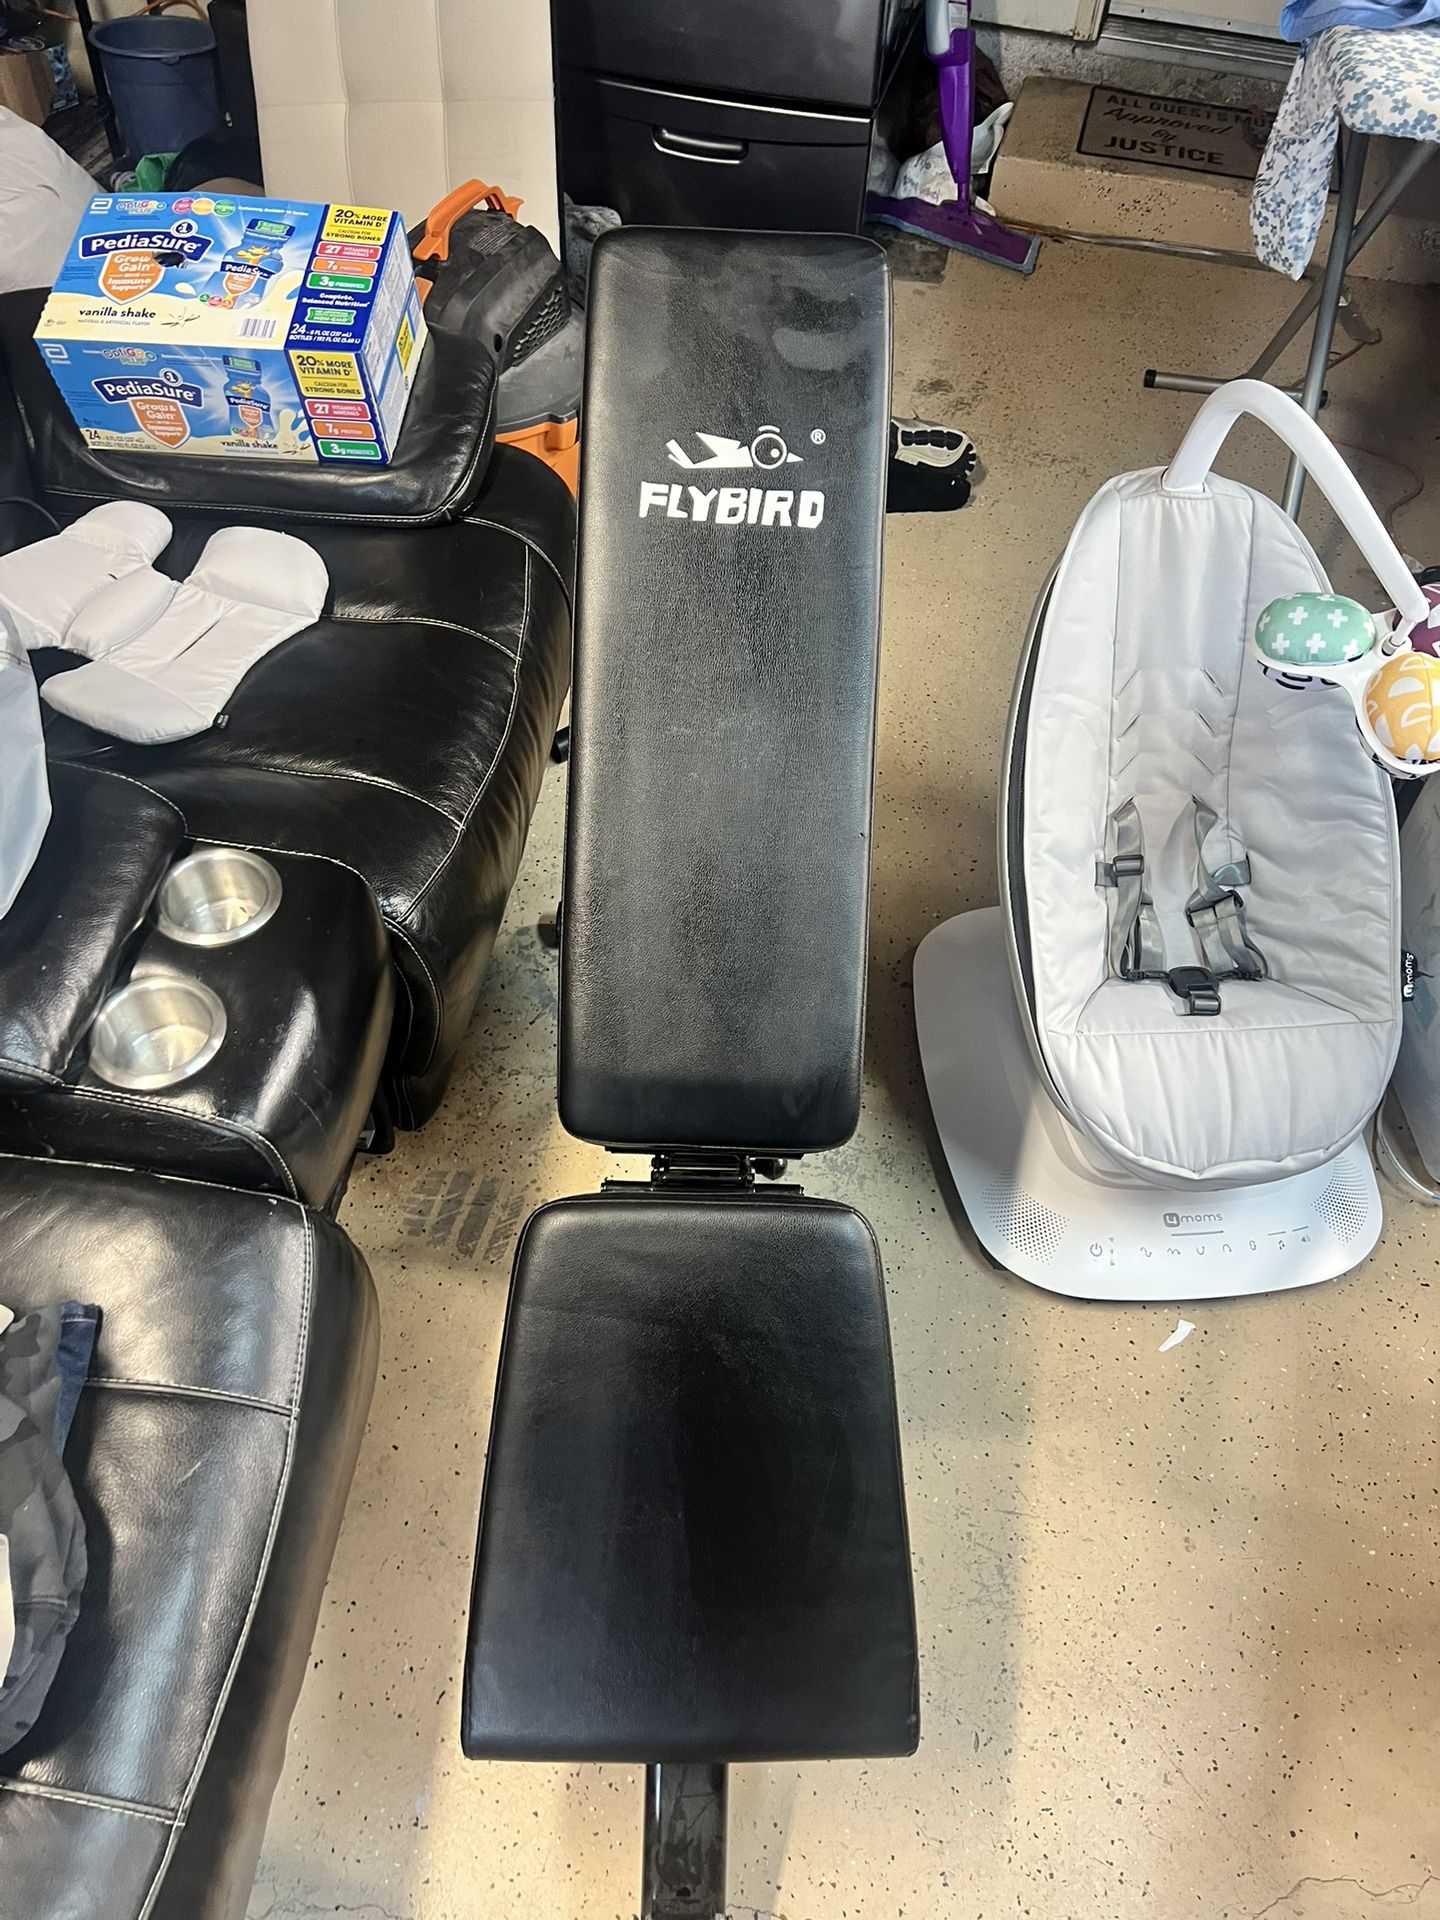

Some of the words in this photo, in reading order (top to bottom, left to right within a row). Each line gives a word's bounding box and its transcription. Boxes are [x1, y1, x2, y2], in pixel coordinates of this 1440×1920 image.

[1106, 94, 1143, 109] ALL
[1150, 101, 1228, 122] GUESTS
[1103, 107, 1233, 135] Approved
[1103, 136, 1224, 165] JUSTICE
[334, 209, 360, 219] 20%
[362, 214, 388, 222] MORE
[333, 218, 373, 227] VITAMIN
[91, 234, 199, 253] PediaSure
[324, 245, 342, 254] 27
[119, 262, 150, 272] Gain
[79, 307, 117, 317] vanilla
[120, 308, 156, 318] shake
[290, 323, 307, 334] 24
[296, 355, 324, 366] 20%
[326, 360, 353, 369] MORE
[300, 367, 341, 376] VITAMIN
[103, 381, 194, 401] PediaSure
[336, 387, 361, 395] BONES
[136, 402, 168, 411] Grow
[314, 403, 329, 415] 27
[146, 410, 174, 420] Gain
[86, 429, 101, 440] 24
[639, 481, 825, 529] FLYBIRD
[1163, 1213, 1223, 1227] 4moms
